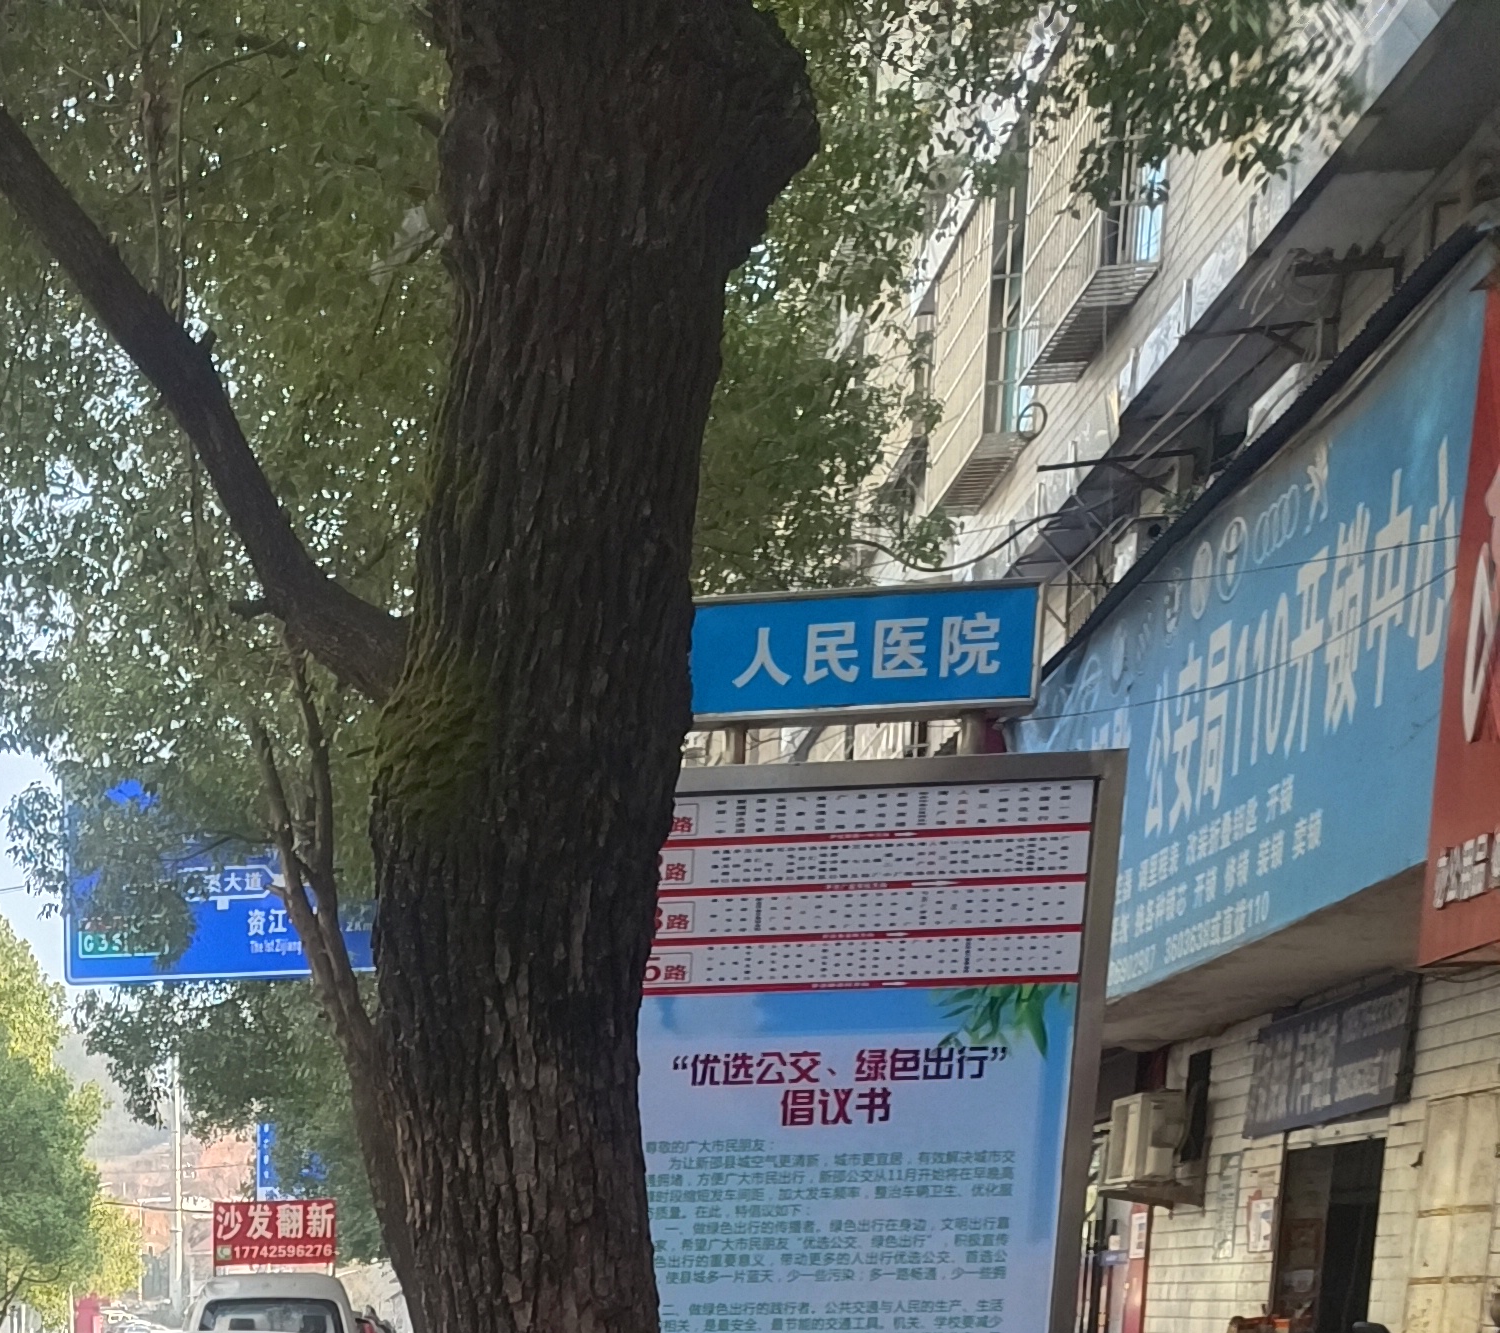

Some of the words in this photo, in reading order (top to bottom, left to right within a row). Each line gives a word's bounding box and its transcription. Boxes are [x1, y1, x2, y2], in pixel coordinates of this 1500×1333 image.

[732, 612, 1001, 688] 人民医院
[672, 1045, 1008, 1087] “优选公交、绿色出行”
[780, 1086, 892, 1127] 倡议书
[216, 1202, 335, 1241] 沙发翻新
[233, 1244, 333, 1260] 17742596276
